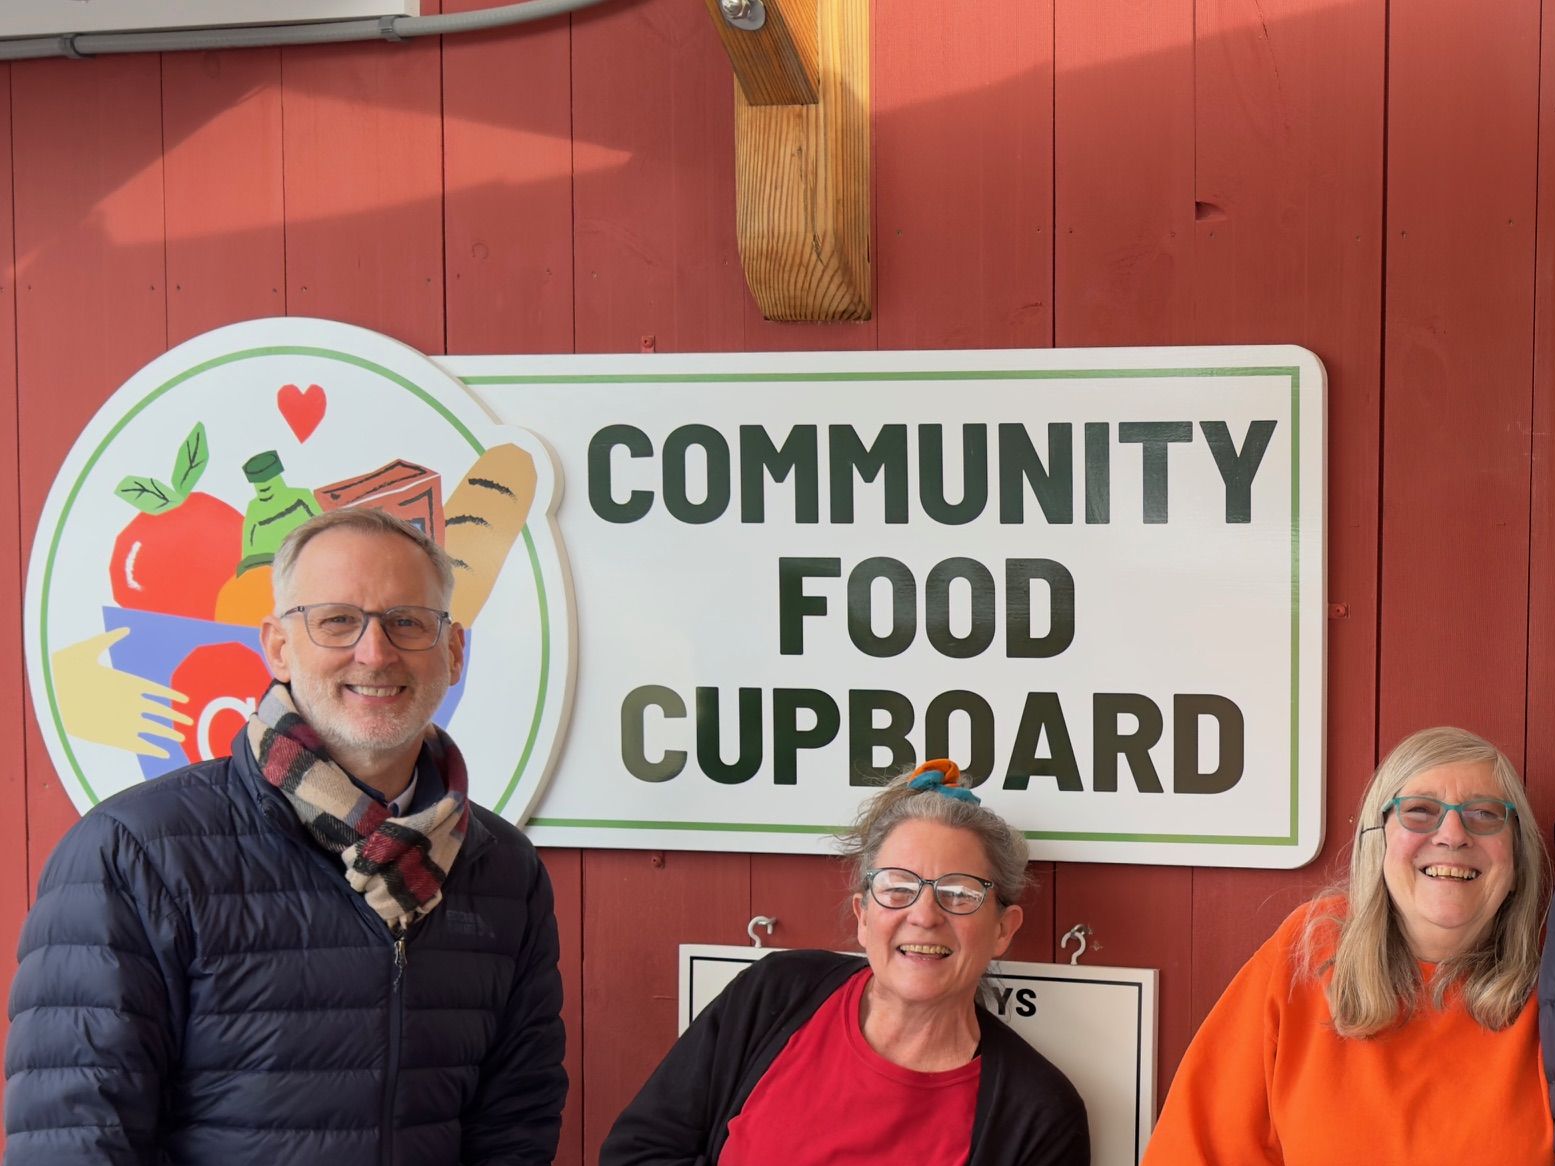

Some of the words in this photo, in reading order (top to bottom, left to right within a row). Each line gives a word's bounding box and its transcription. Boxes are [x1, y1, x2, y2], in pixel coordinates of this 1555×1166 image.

[587, 420, 1279, 525] COMMUNITY
[778, 556, 1076, 660] FOOD
[620, 684, 1245, 795] CUPBOARD
